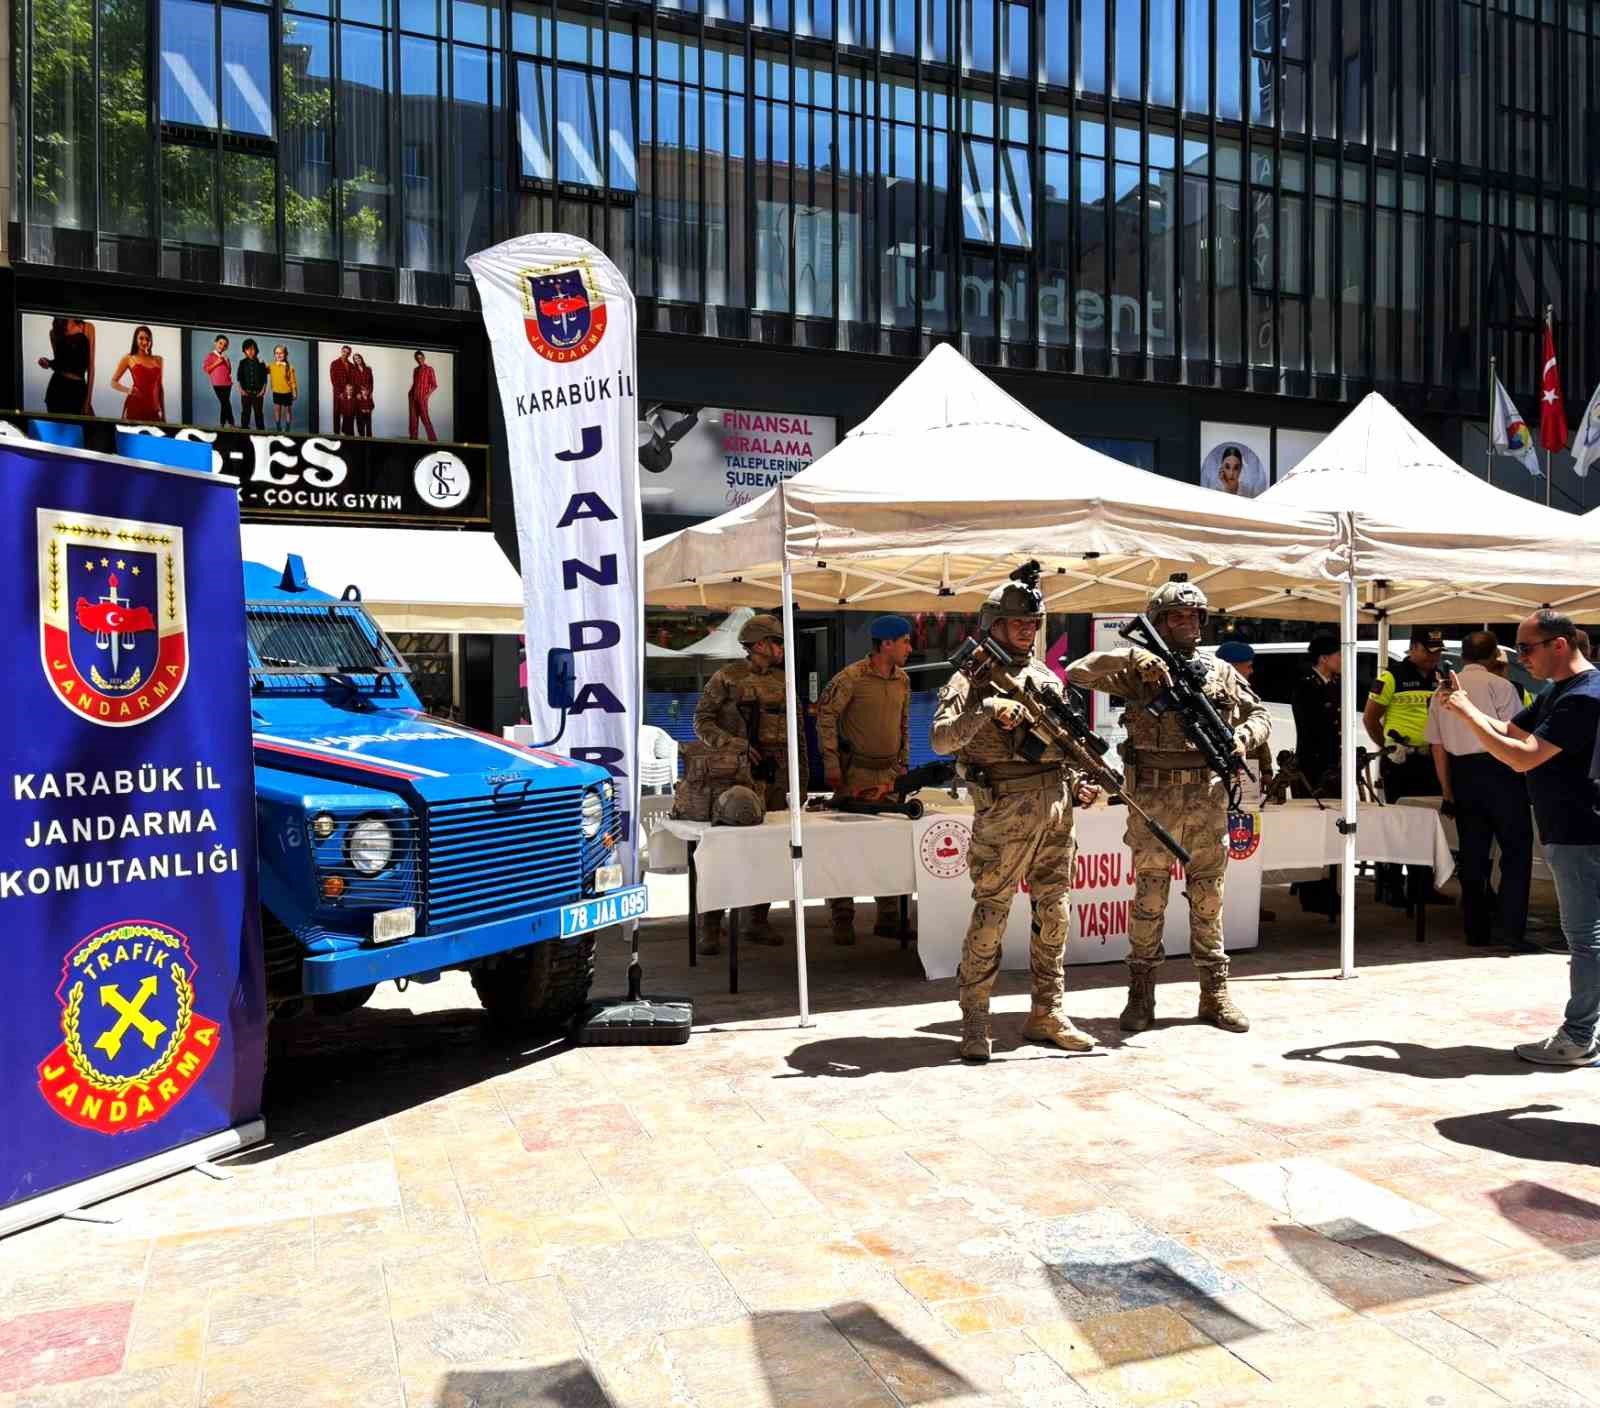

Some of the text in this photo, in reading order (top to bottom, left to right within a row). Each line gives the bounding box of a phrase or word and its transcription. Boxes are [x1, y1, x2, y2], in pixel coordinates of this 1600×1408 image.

[896, 255, 1165, 338] lumident
[531, 323, 604, 361] JANDARMA
[516, 370, 635, 417] KARABÜK İL
[723, 410, 813, 436] FİNANSAL
[722, 433, 813, 457] KİRALAMA
[725, 455, 813, 473] TALEPLERİNİZ
[264, 488, 338, 507] ÇOCUK
[726, 471, 793, 488] ŞUBEMİ
[53, 659, 180, 716] JANDARMA
[13, 761, 221, 801] KARABÜK İL
[24, 808, 217, 848] JANDARMA
[0, 843, 239, 899] KOMUTANLIĞI
[569, 892, 646, 933] 78 JAA 095
[83, 941, 171, 981] TRAFİK
[43, 1026, 216, 1123] JANDARMA
